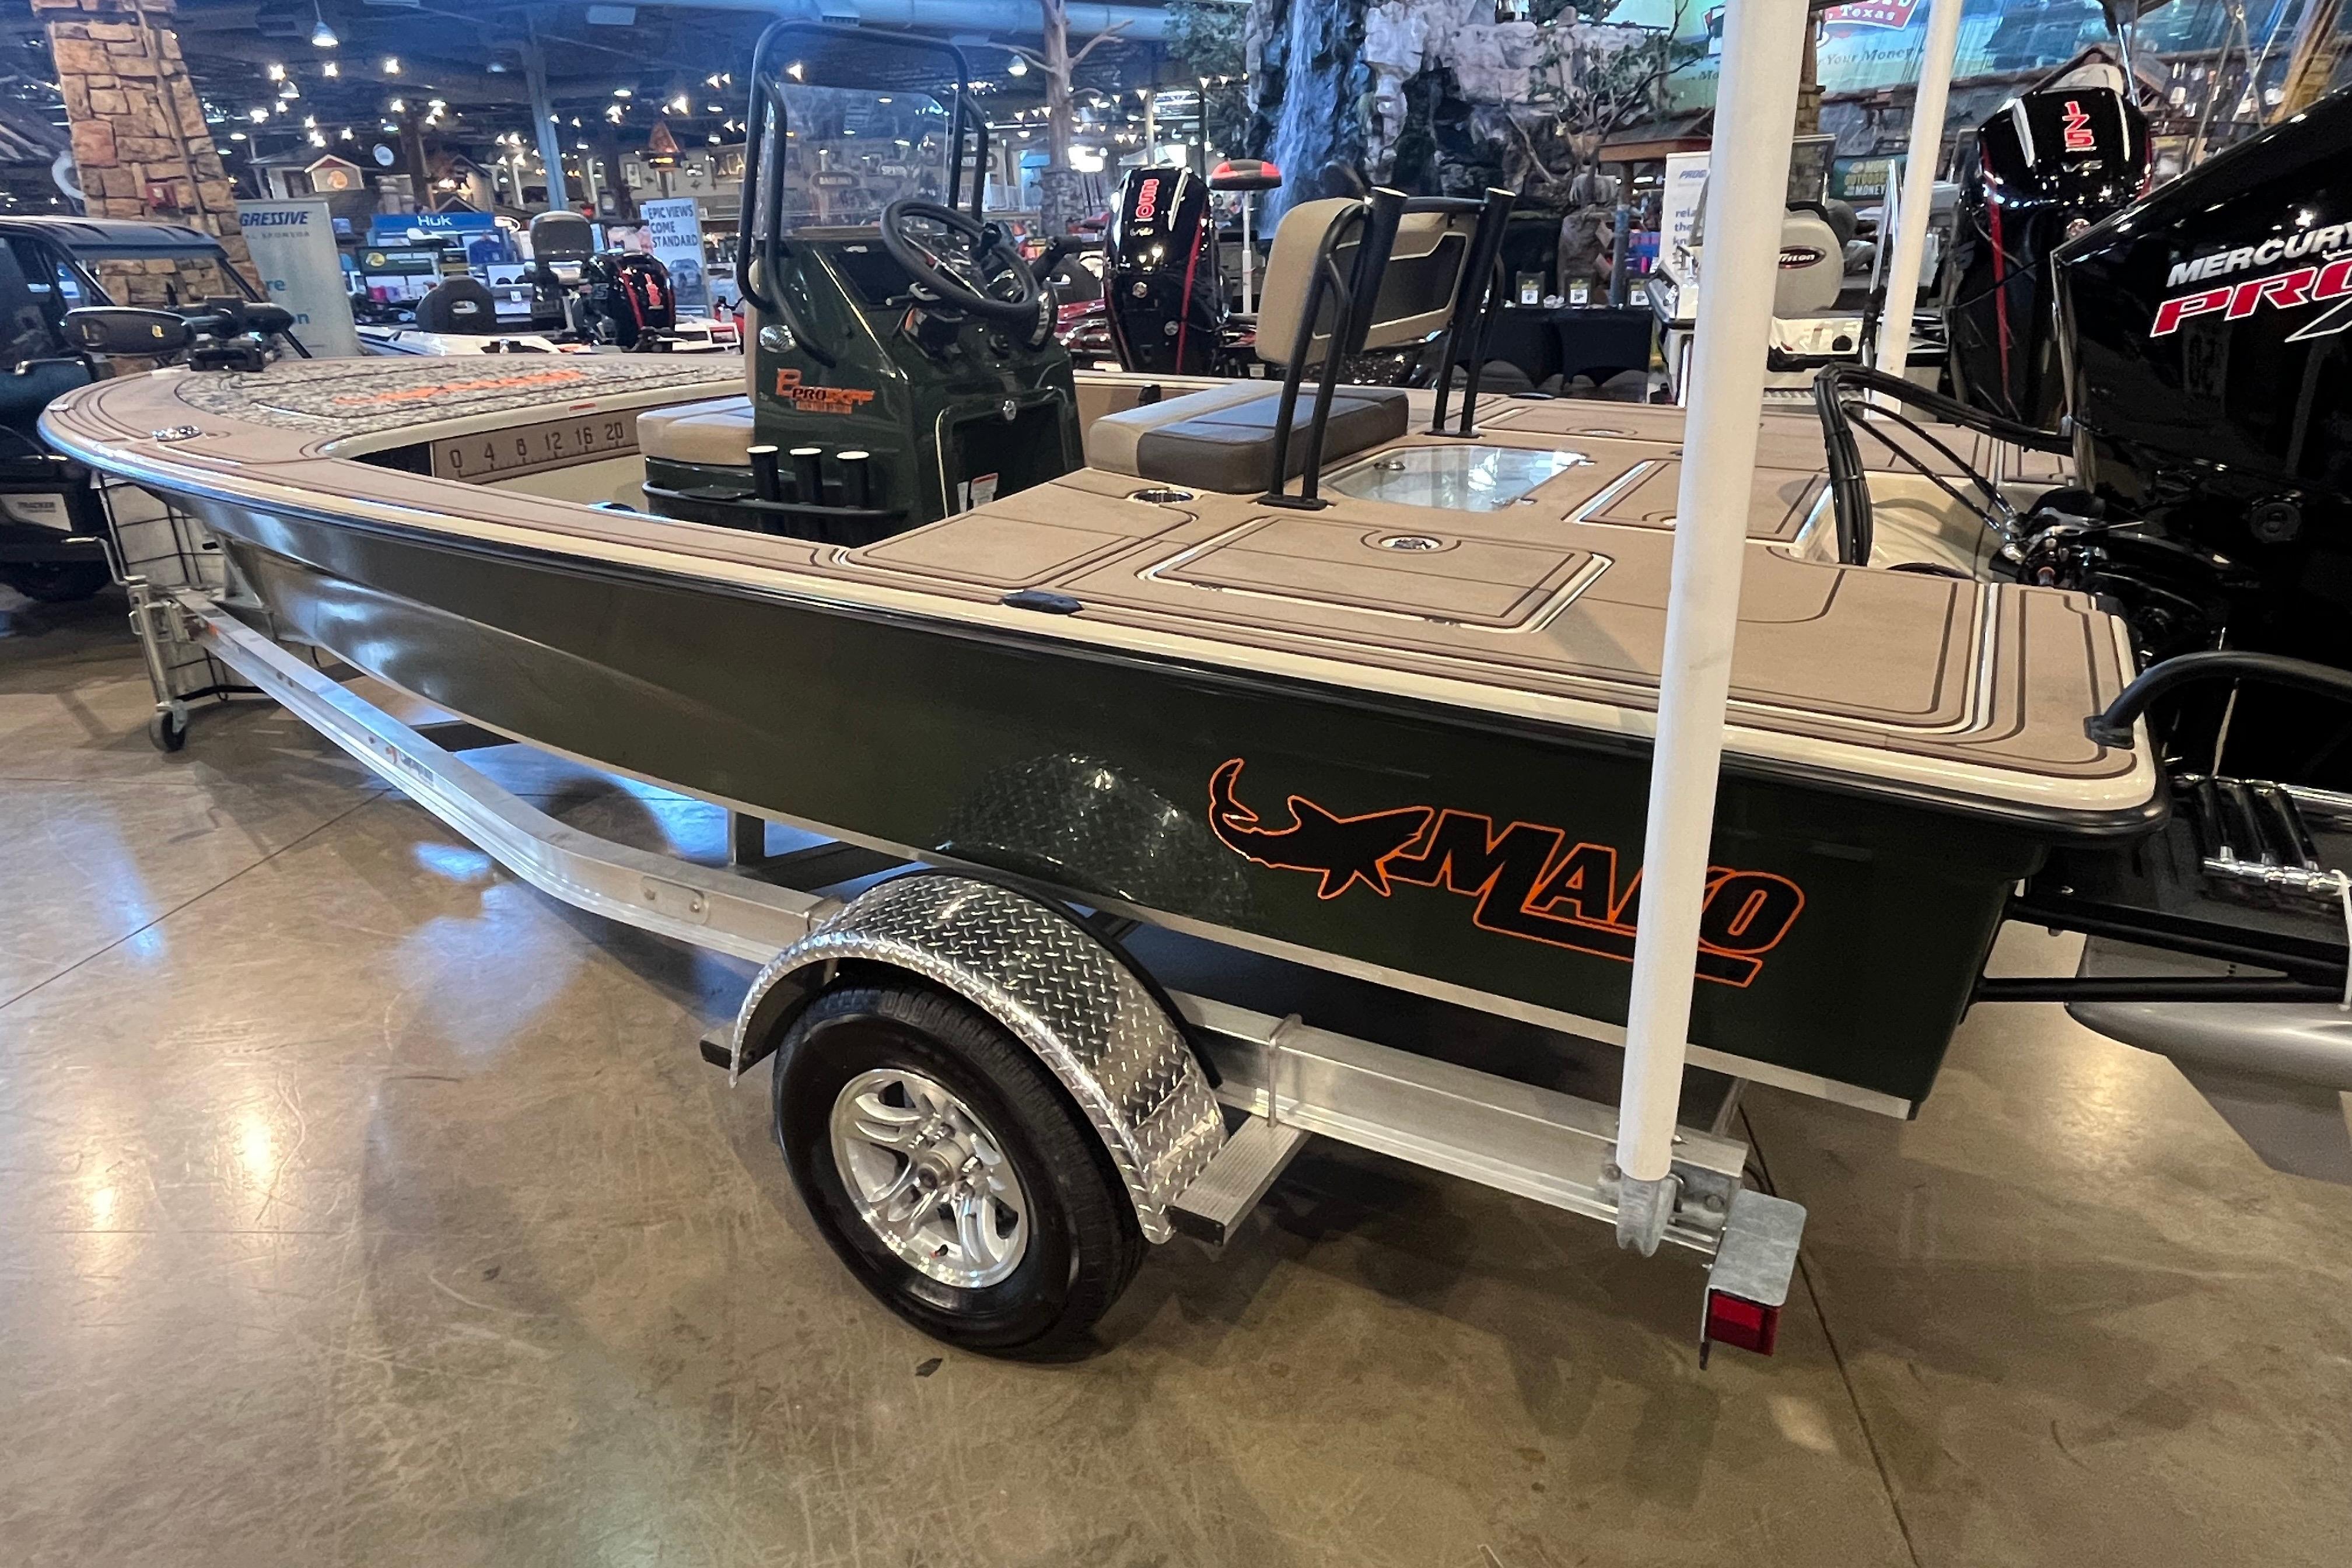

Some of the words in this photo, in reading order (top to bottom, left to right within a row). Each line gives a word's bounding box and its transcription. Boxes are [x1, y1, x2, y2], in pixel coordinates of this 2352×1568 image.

[1840, 5, 1895, 21] Texas
[1826, 53, 1858, 65] Your
[2062, 100, 2095, 147] 175
[648, 206, 667, 220] EPIC
[667, 204, 694, 218] VIEWS
[650, 220, 676, 233] COME
[652, 234, 698, 247] STANDARD
[792, 388, 827, 401] PRO
[449, 449, 463, 468] 0
[484, 442, 494, 461] 4
[516, 438, 527, 456] 8
[545, 432, 563, 451] 12
[575, 427, 594, 446] 16
[604, 422, 624, 441] 20
